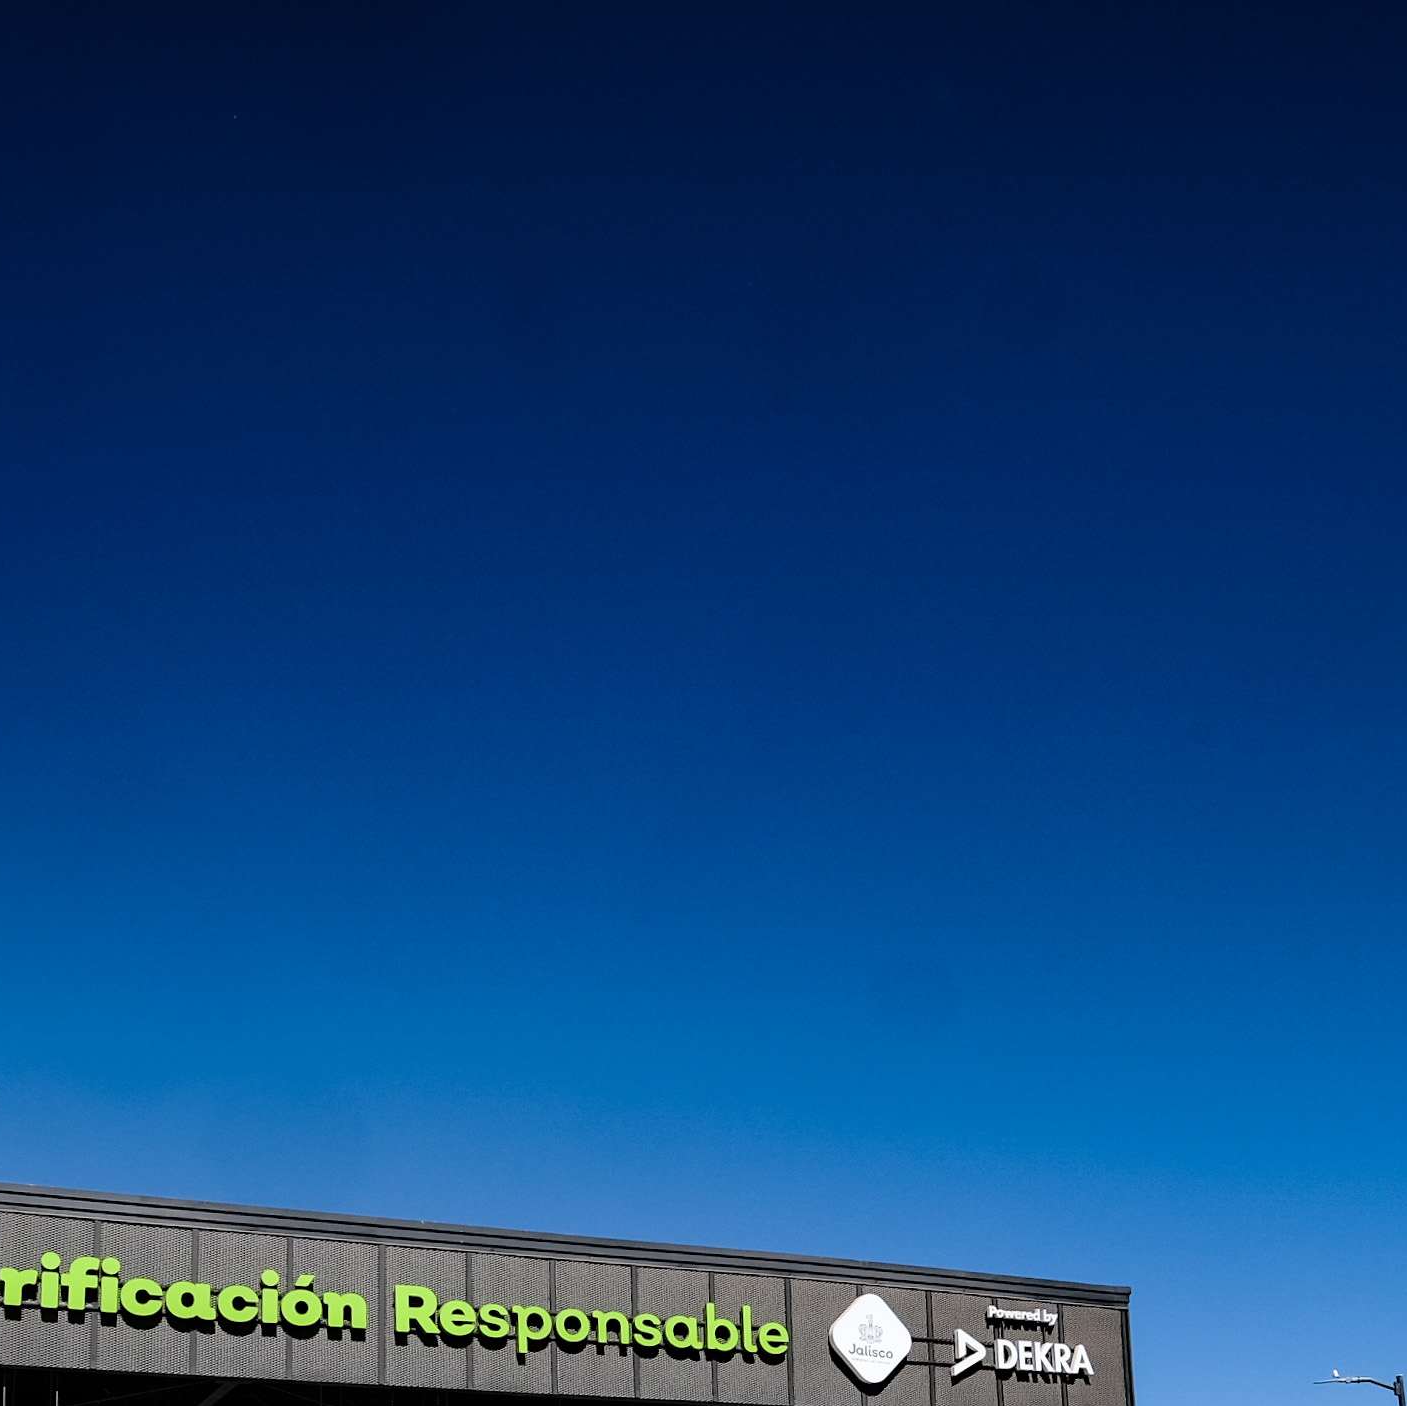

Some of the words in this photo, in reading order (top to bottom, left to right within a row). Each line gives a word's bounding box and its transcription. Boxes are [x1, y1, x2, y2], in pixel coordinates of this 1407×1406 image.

[394, 1284, 790, 1355] Responsable
[987, 1305, 1041, 1322] Powered
[1042, 1308, 1059, 1327] by
[848, 1344, 894, 1359] Jalisco
[994, 1338, 1095, 1376] DEKRA
